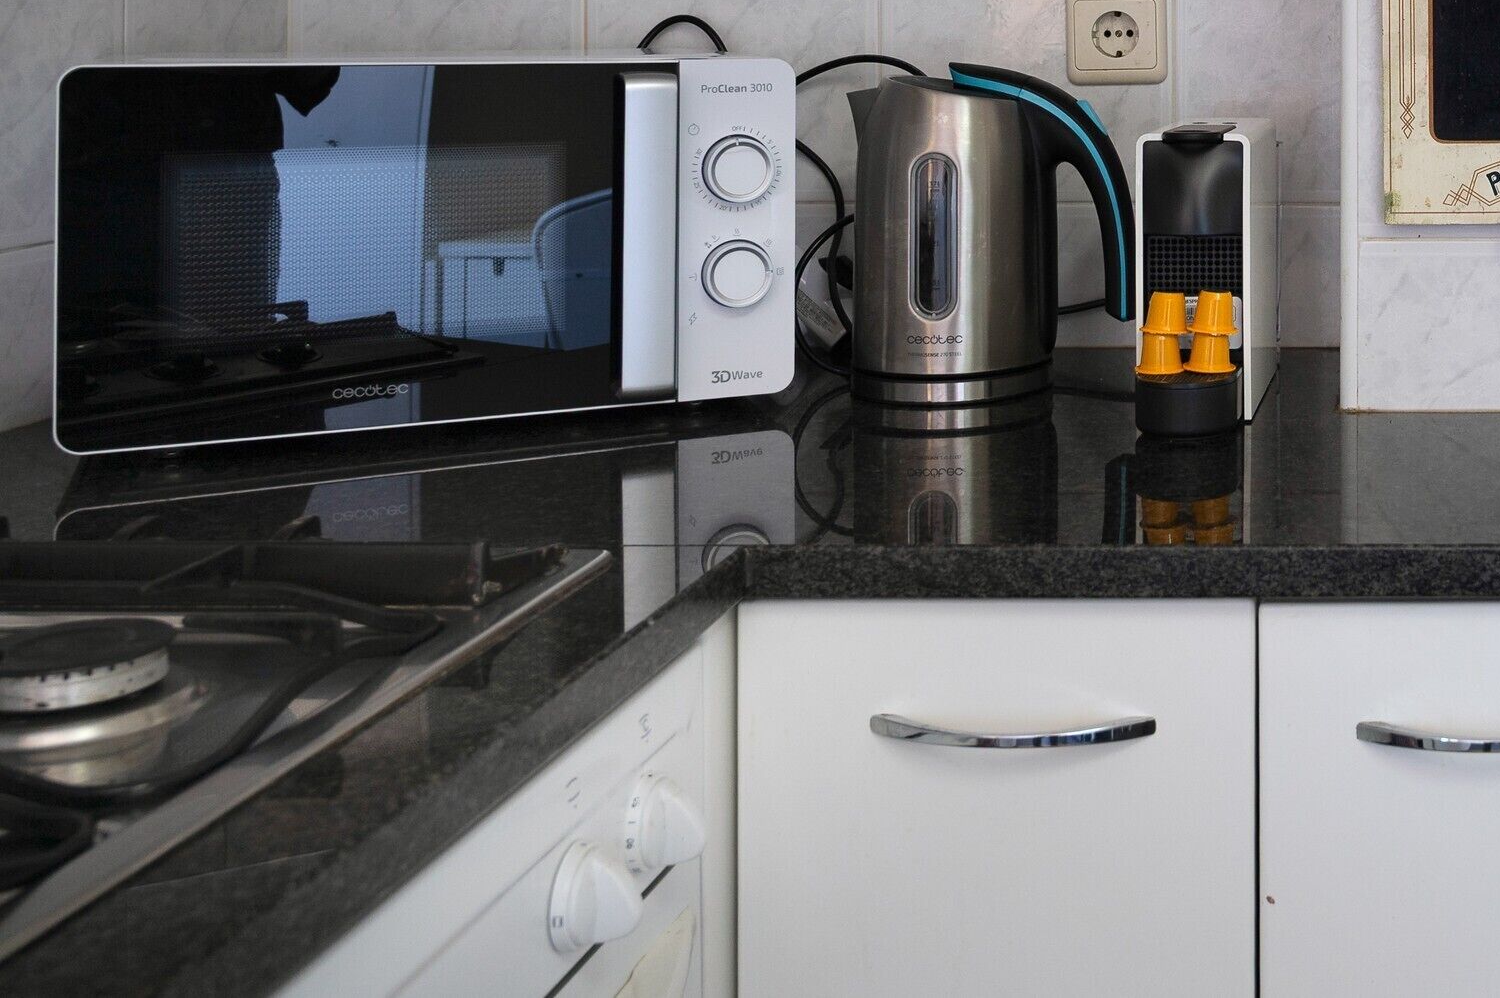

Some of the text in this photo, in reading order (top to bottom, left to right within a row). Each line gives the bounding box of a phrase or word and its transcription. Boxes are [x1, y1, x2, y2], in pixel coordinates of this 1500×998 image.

[701, 83, 773, 93] ProClean 3010
[907, 334, 963, 345] cecotec
[332, 383, 409, 399] cecotec
